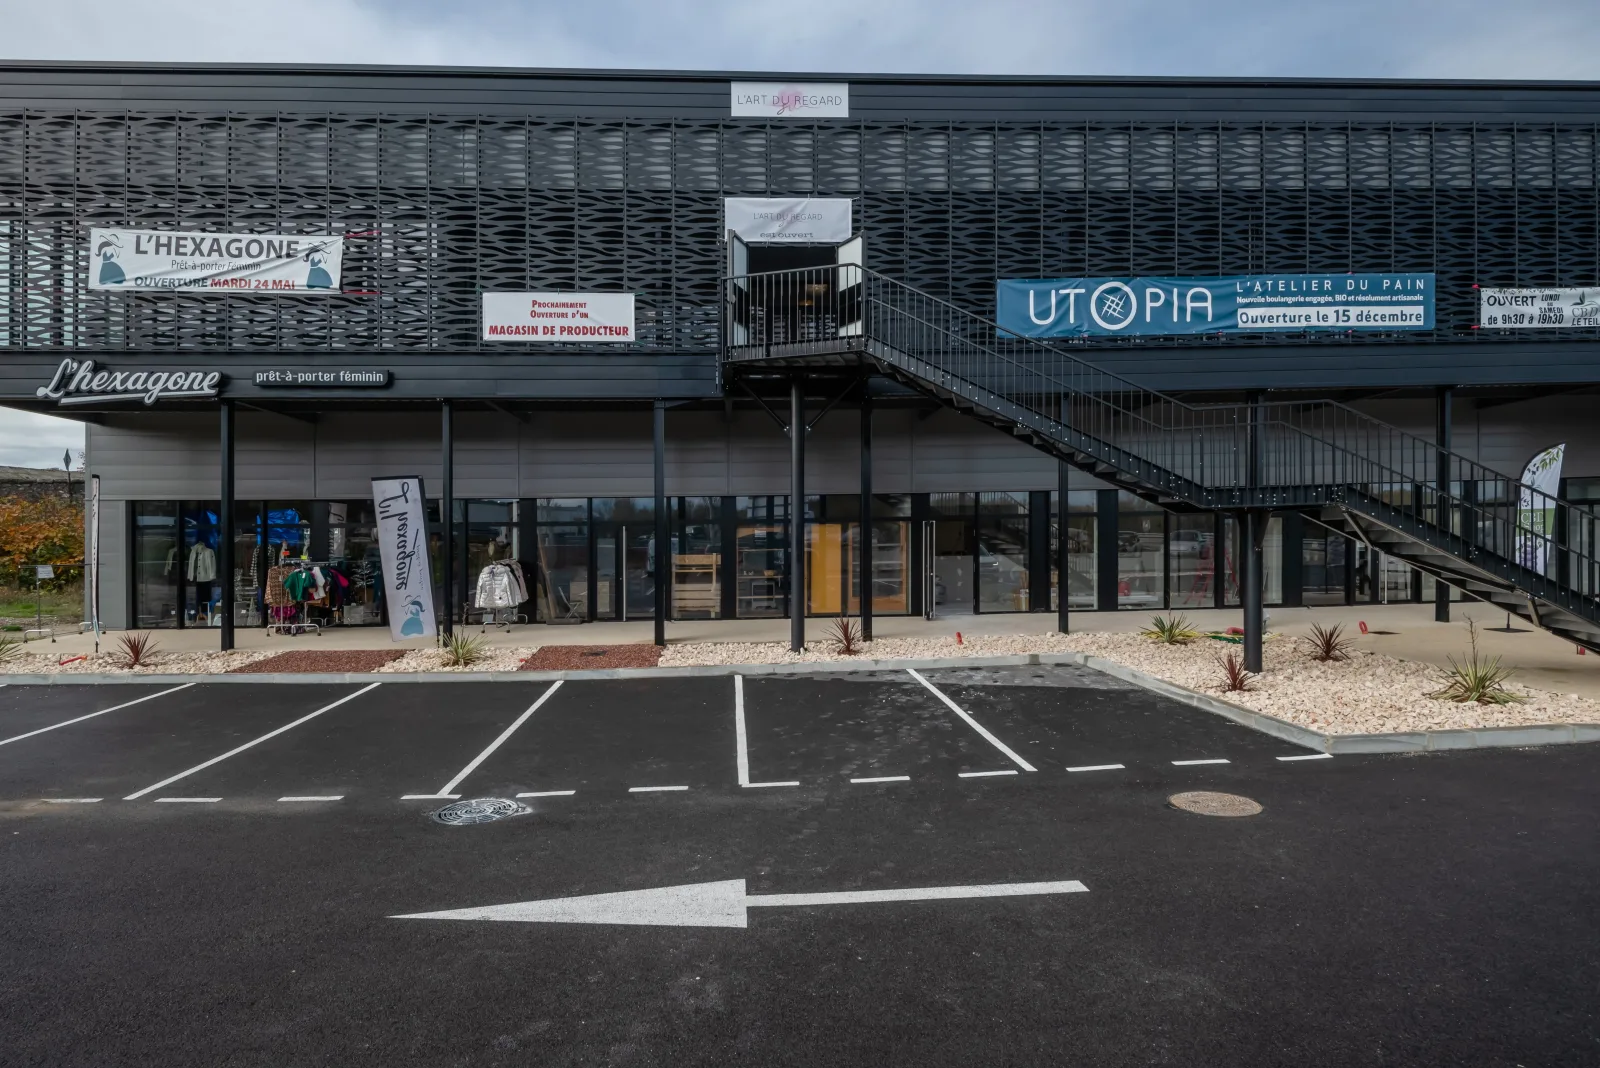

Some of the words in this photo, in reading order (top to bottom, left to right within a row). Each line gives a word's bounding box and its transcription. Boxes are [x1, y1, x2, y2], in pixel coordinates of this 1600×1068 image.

[737, 95, 767, 105] L'ART
[772, 95, 790, 107] DU
[794, 95, 842, 106] REGARD
[776, 213, 788, 221] DU
[135, 234, 300, 259] L'HEXAGONE
[171, 259, 225, 272] Prêt-à-porter
[227, 261, 262, 271] Féminin
[134, 276, 208, 288] OUVERTURE
[210, 277, 252, 289] MARDI
[254, 279, 269, 289] 24
[271, 279, 296, 290] MAI
[1236, 280, 1332, 292] L'ATELIER
[1347, 279, 1368, 290] DU
[1383, 279, 1424, 290] PAIN
[1236, 295, 1265, 304] Nouvelle
[1266, 295, 1304, 303] boulangerie
[1305, 294, 1334, 304] engagée,
[1335, 294, 1347, 302] BIO
[1486, 295, 1537, 306] OUVERT
[1541, 293, 1561, 301] LUNDI
[1029, 281, 1212, 330] UTOPIA
[1538, 306, 1564, 314] SAMEDI
[1571, 306, 1599, 317] CBD
[1239, 311, 1312, 324] Ouverture
[1316, 310, 1329, 323] le
[1333, 309, 1351, 323] 15
[1355, 310, 1422, 322] décembre
[1487, 314, 1498, 325] de
[1501, 313, 1525, 325] 9h30
[1527, 313, 1534, 324] à
[1538, 313, 1564, 325] 19h30
[1571, 317, 1582, 326] LE
[488, 325, 539, 336] MAGASIN
[542, 325, 556, 336] DE
[559, 325, 629, 336] PRODUCTEUR
[36, 358, 221, 403] L'hexagone
[256, 370, 337, 383] prêt-à-porter
[339, 370, 383, 382] féminin
